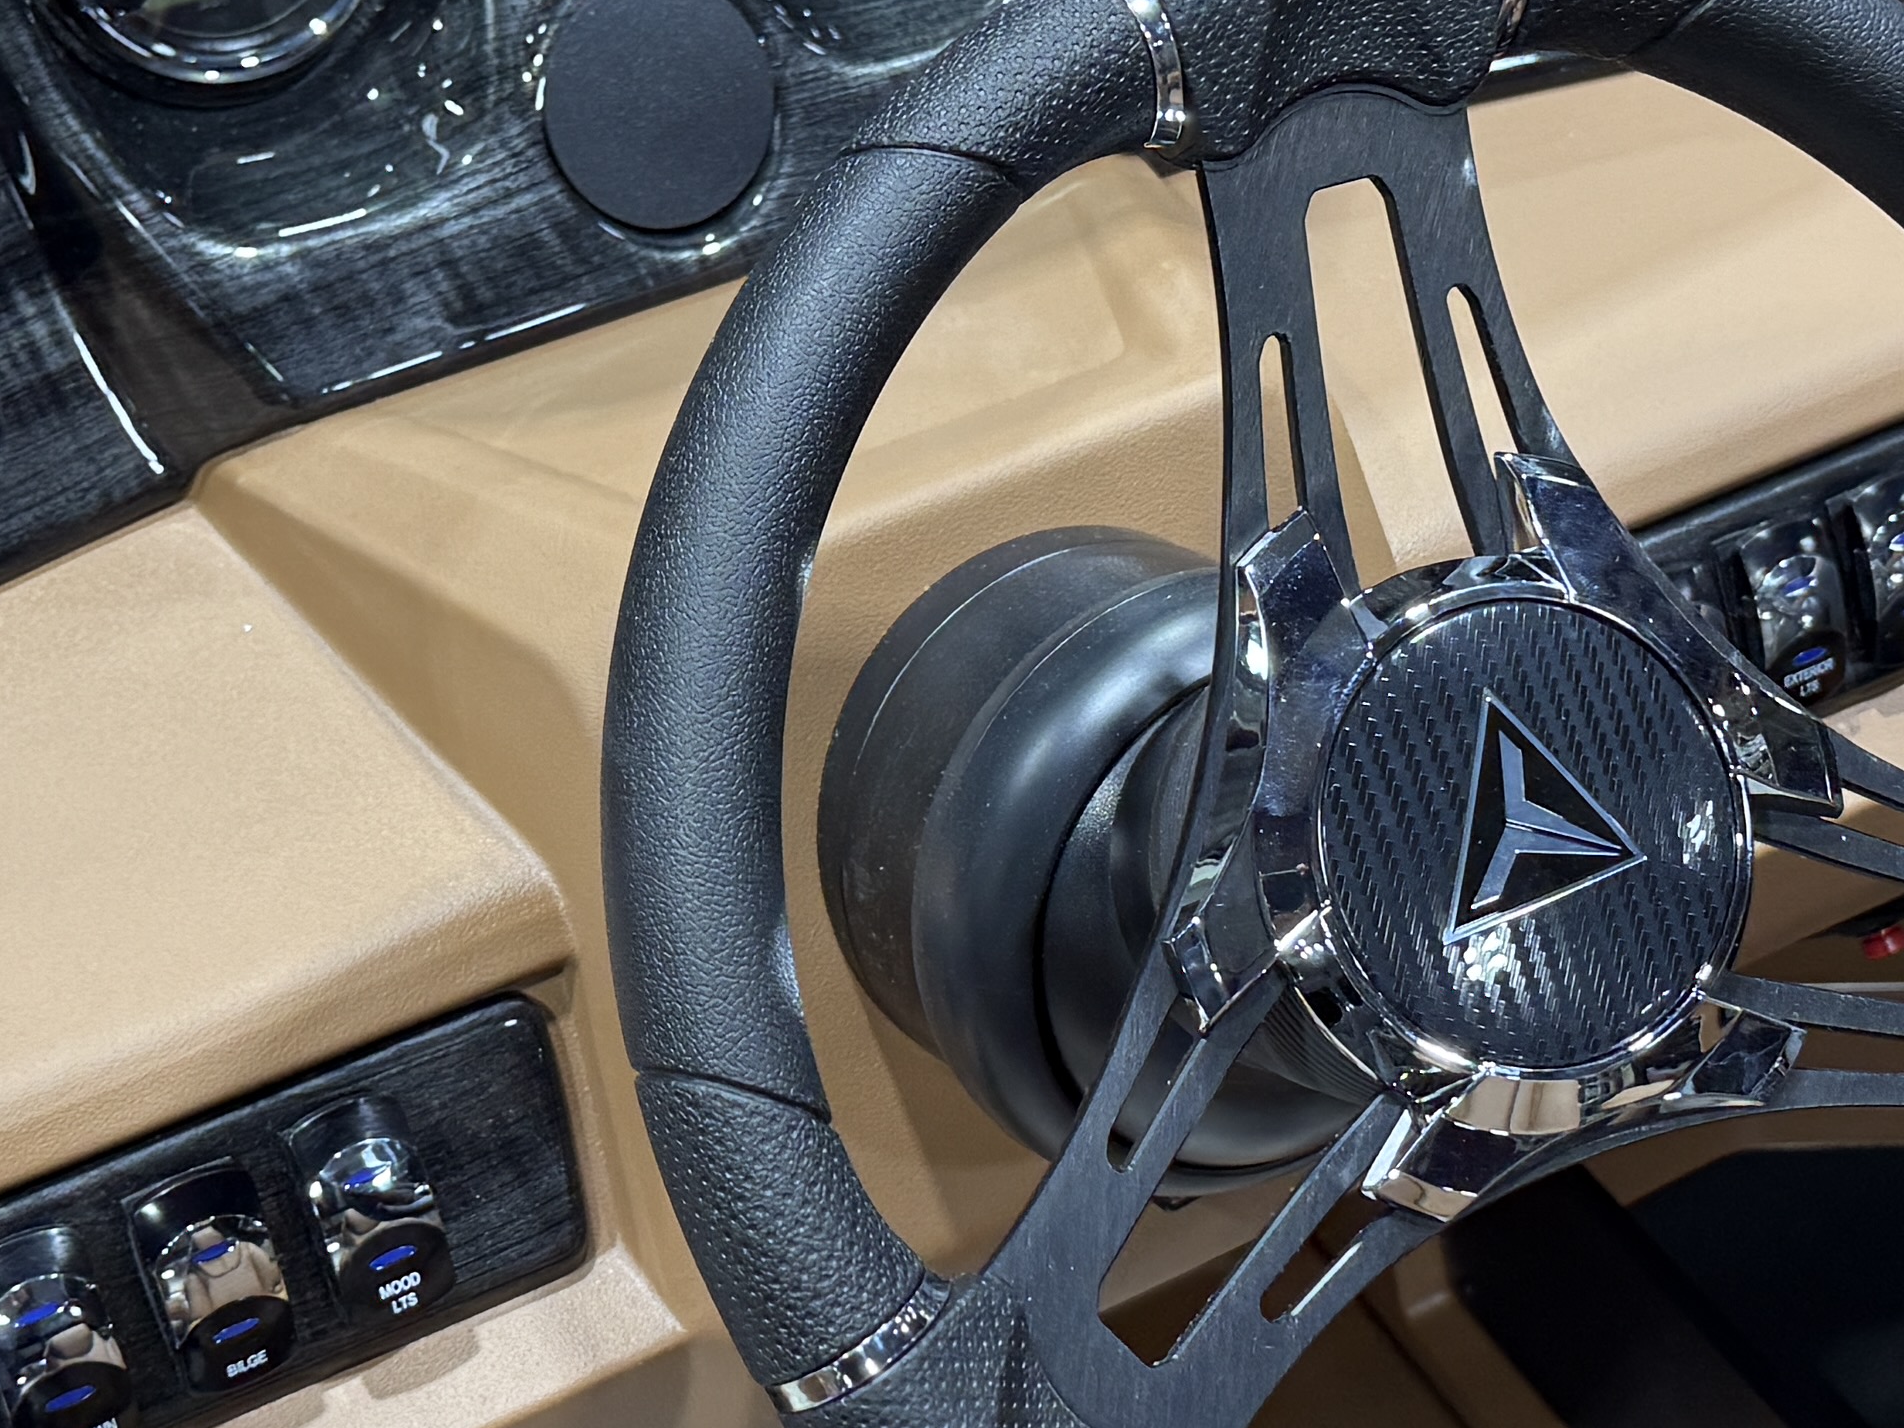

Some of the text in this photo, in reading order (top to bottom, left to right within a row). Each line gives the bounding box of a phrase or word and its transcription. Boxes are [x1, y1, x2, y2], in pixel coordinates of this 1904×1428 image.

[1783, 657, 1835, 689] EXTERIOR
[378, 1271, 422, 1300] MOOD
[391, 1292, 419, 1314] LTS
[226, 1348, 269, 1378] BILGE
